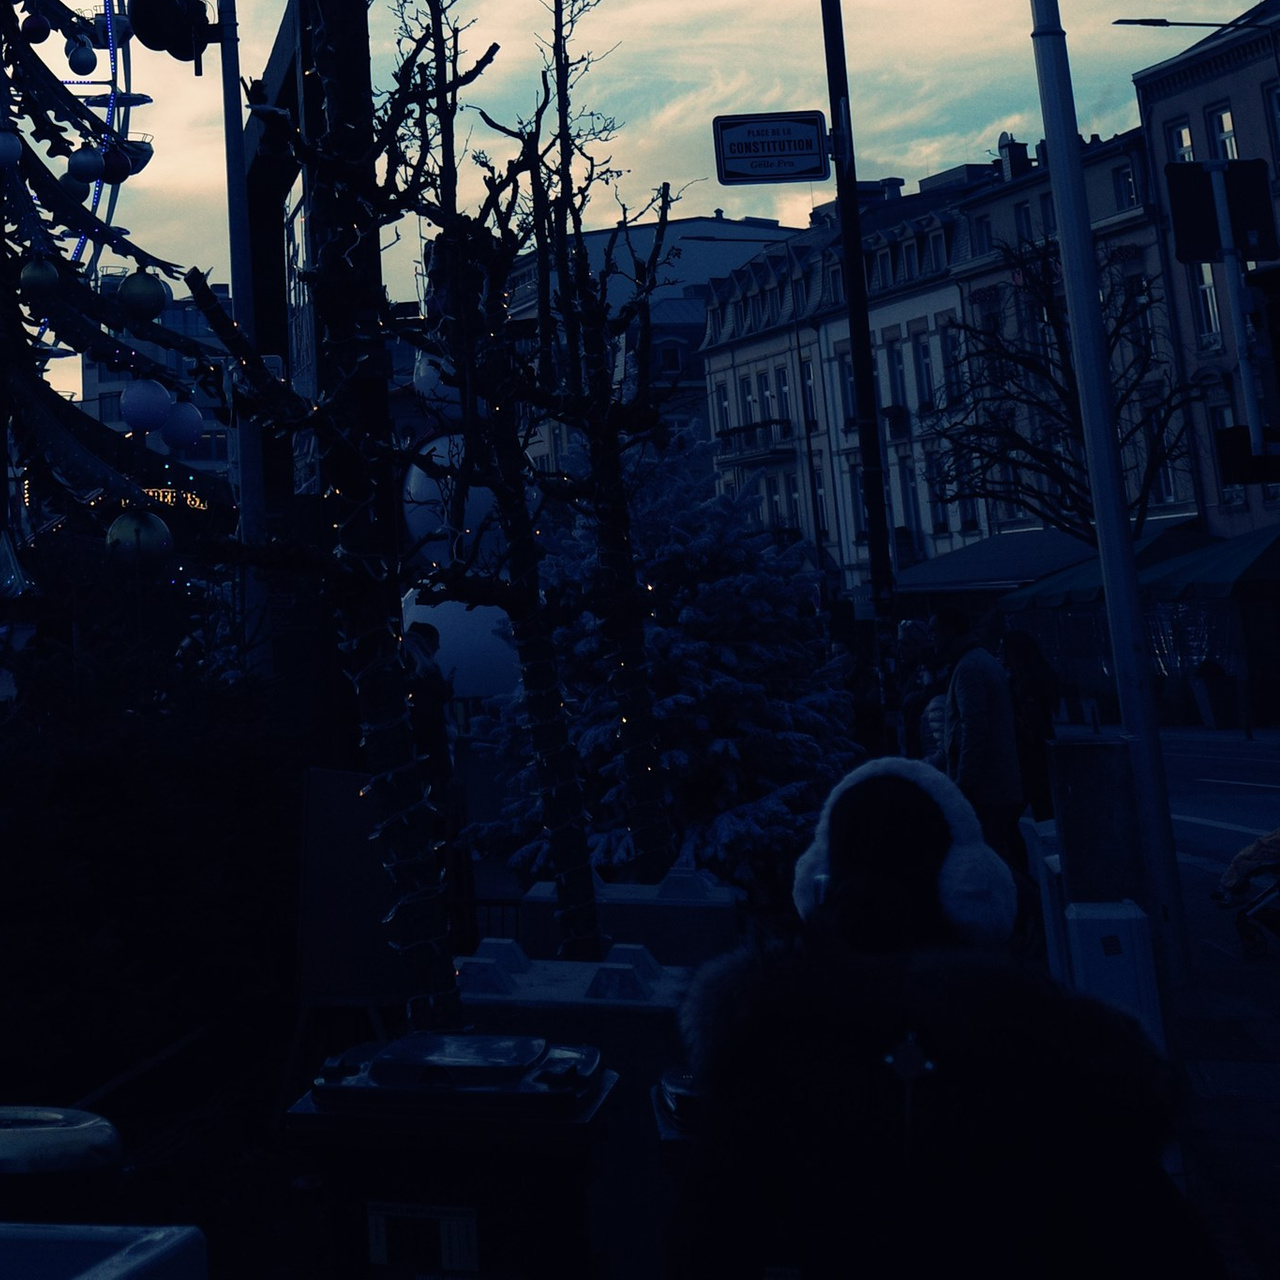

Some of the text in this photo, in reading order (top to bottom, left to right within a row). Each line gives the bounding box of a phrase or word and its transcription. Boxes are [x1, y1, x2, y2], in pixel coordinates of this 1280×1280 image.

[747, 128, 770, 138] PLACE
[729, 138, 813, 155] CONSTITUTION
[776, 159, 795, 169] Fra
